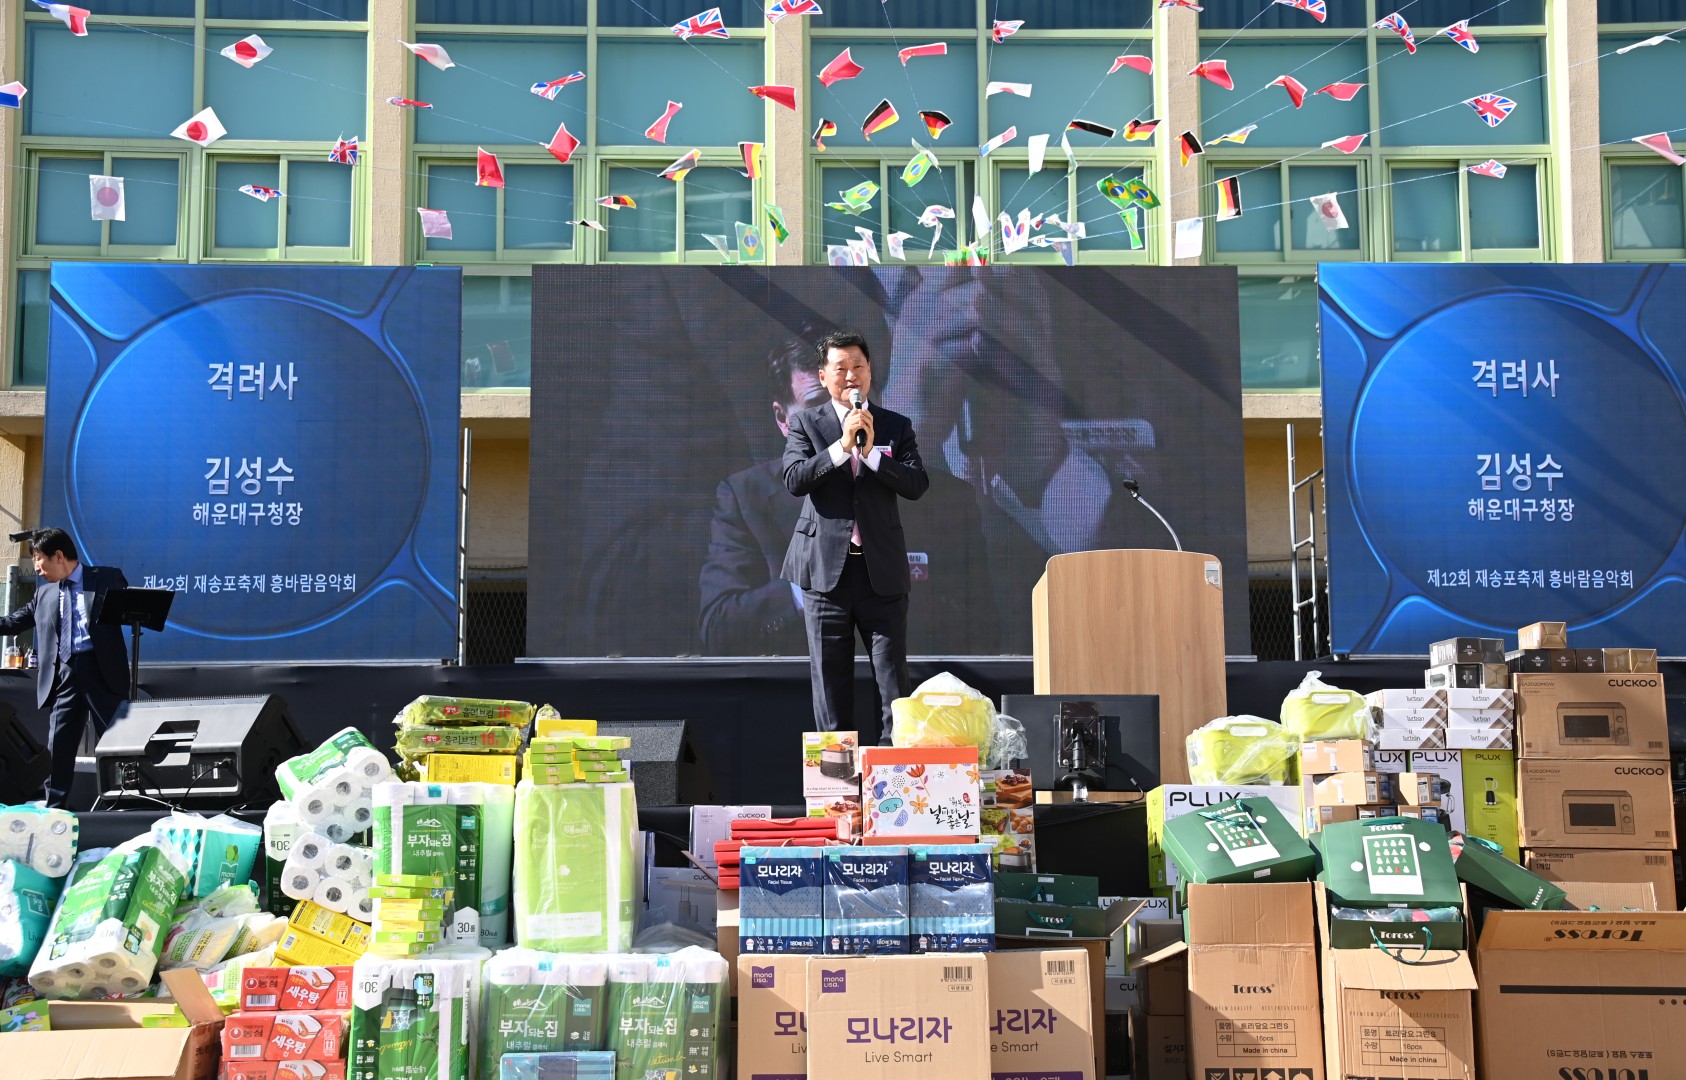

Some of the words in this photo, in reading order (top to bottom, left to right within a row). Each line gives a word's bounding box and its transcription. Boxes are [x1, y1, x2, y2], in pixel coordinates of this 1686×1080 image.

[207, 362, 298, 400] 격려사
[1472, 359, 1560, 398] 격려사
[204, 456, 295, 496] 김성수
[1476, 453, 1564, 492] 김성수
[192, 502, 303, 526] 해운대구청장
[1468, 498, 1575, 521] 해운대구청장
[143, 574, 189, 593] 제12회
[193, 574, 266, 594] 재송포축제
[270, 573, 357, 593] 흥바람음악회
[1427, 569, 1471, 588] 제12회
[1475, 569, 1545, 589] 재송포축제
[1548, 569, 1634, 589] 흥바람음악회
[1608, 679, 1658, 688] CUCKOO
[1412, 752, 1458, 762] PLUX
[1614, 767, 1665, 776] CUCKOO
[757, 865, 802, 877] 모나리자
[842, 863, 889, 876] 모나리자
[929, 862, 975, 875] 모나리자
[1380, 931, 1414, 939] Toross
[286, 985, 320, 1004] 새우탕
[1232, 984, 1273, 994] Toross
[846, 1017, 953, 1044] 모나리자
[272, 1035, 306, 1054] 새우탕
[506, 1041, 531, 1050] 내추럴
[627, 1039, 652, 1048] 내추럴
[1001, 1041, 1039, 1052] Smart
[1364, 1042, 1378, 1050] 수량
[1403, 1043, 1422, 1051] 16pcs
[865, 1050, 890, 1063] Live
[894, 1050, 933, 1063] Smart
